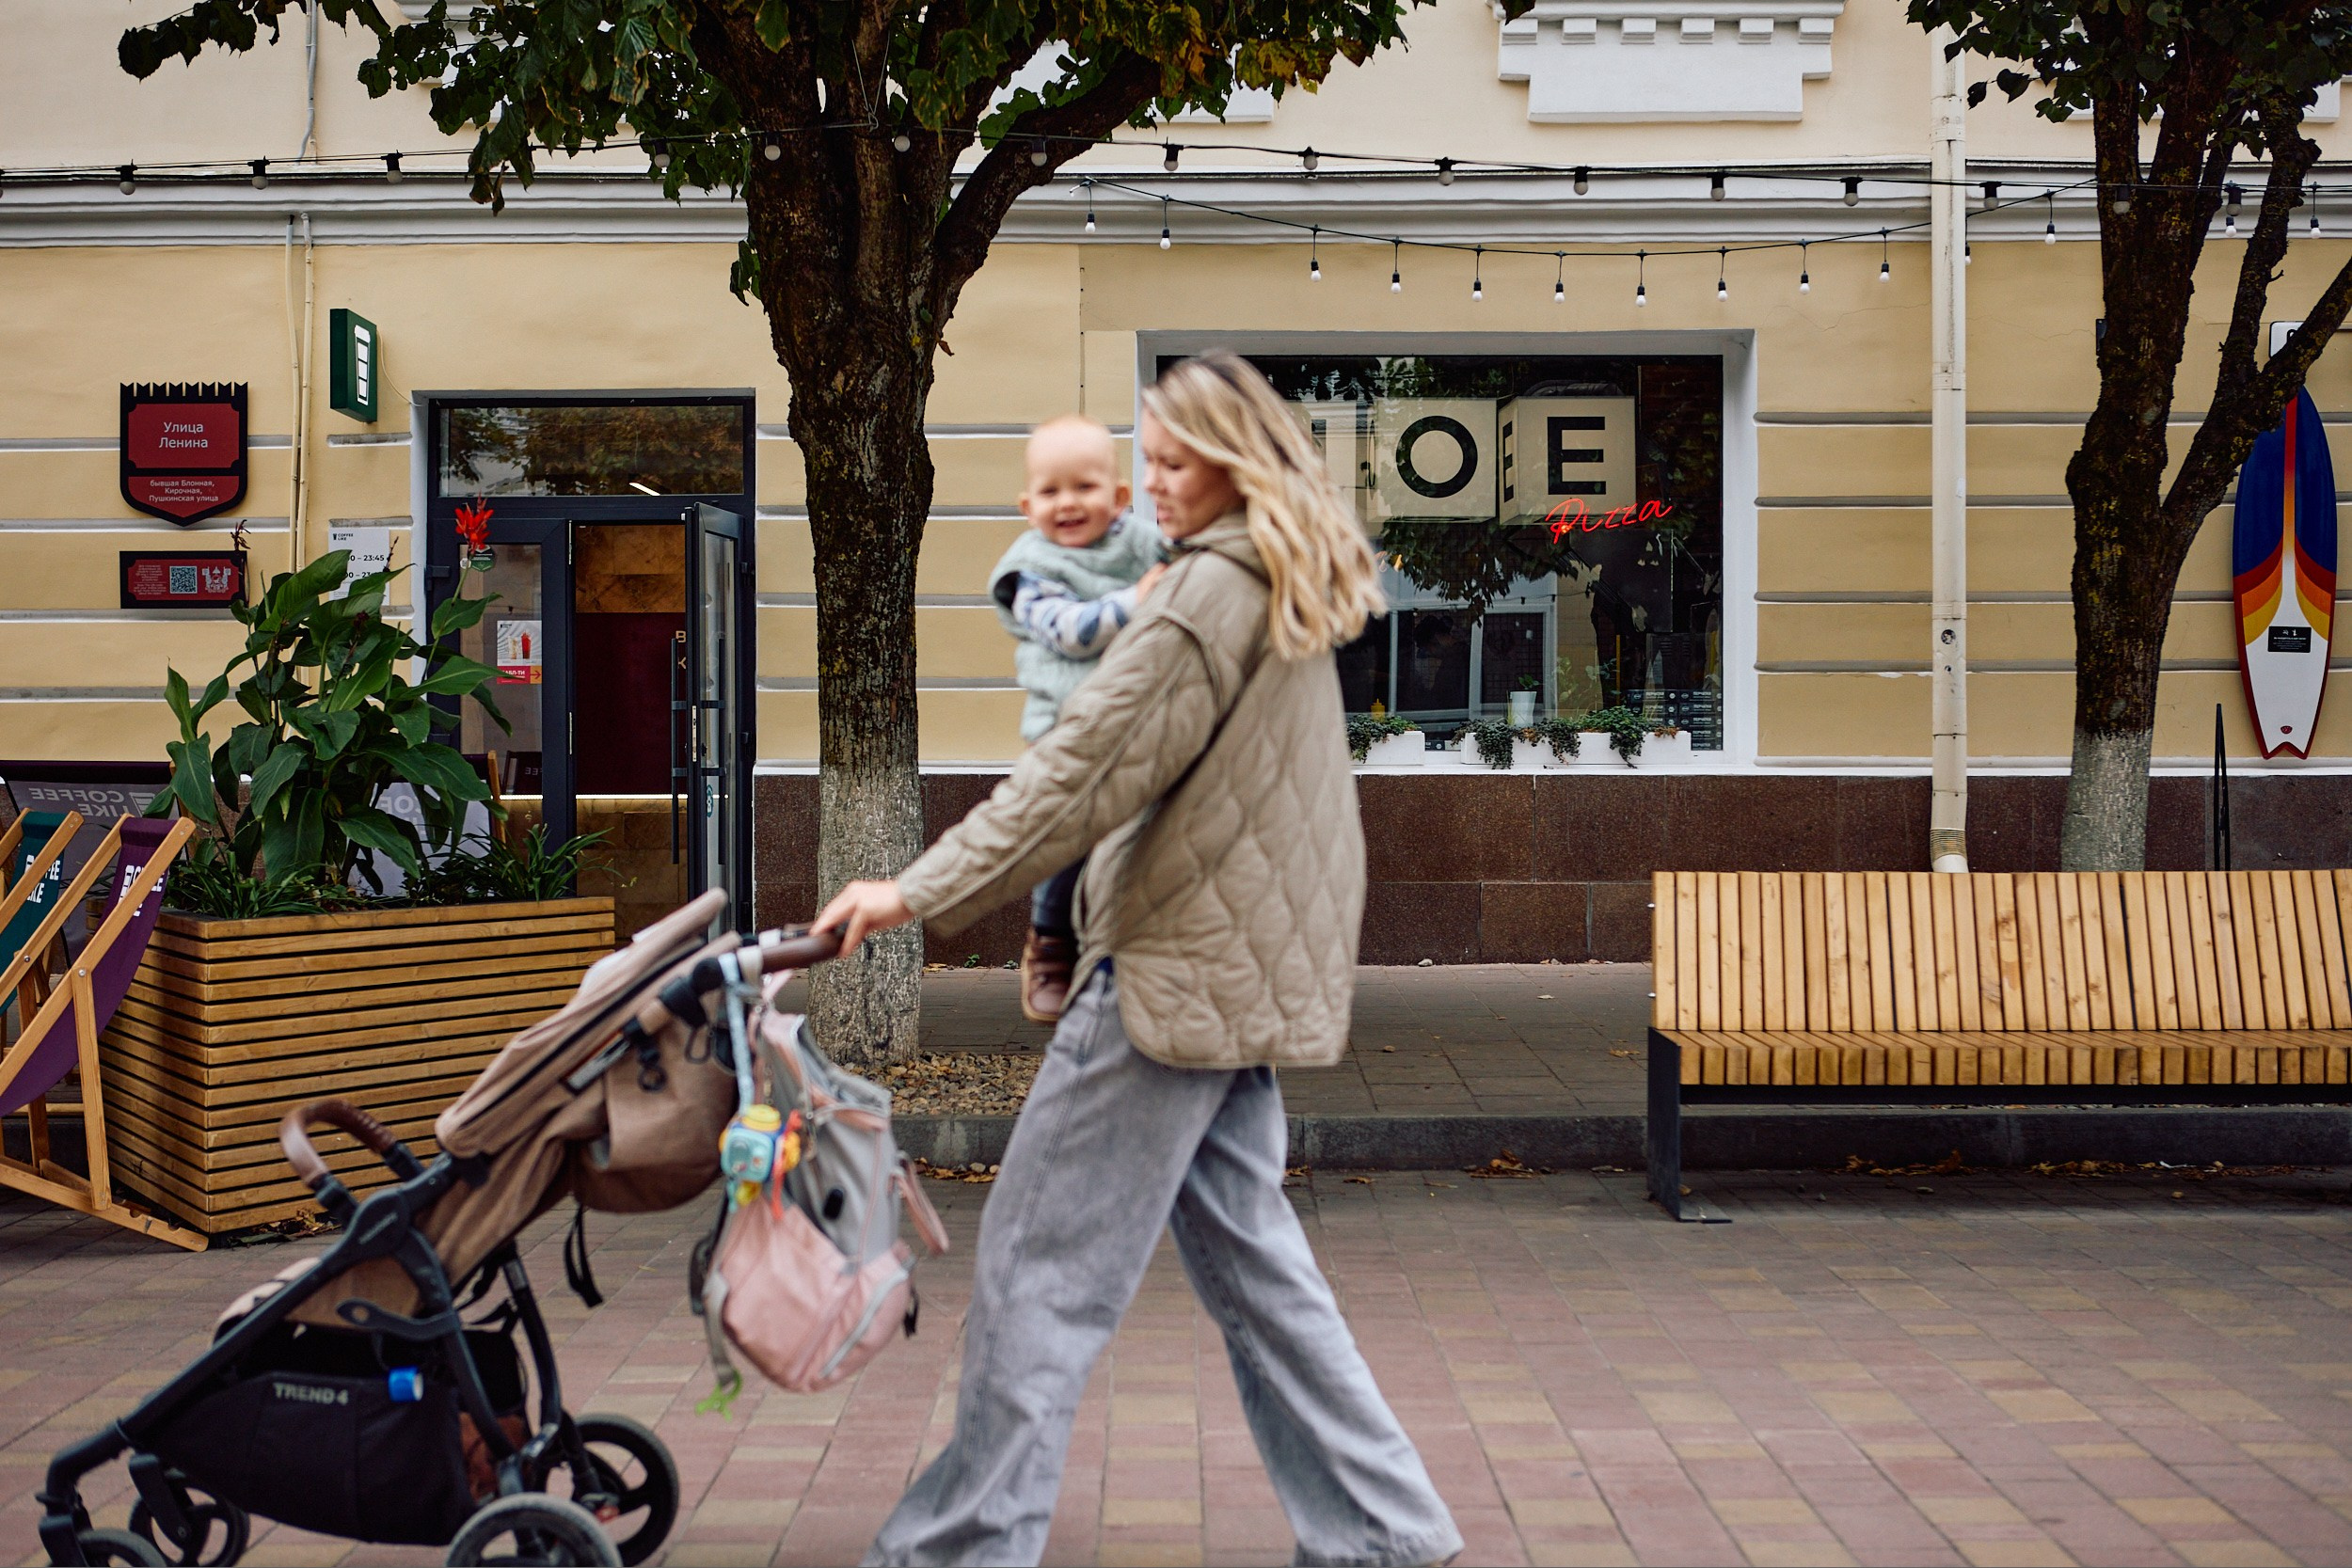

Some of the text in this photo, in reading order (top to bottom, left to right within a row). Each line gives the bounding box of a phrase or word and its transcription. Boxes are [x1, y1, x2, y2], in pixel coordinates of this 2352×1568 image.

[163, 421, 204, 434] Улица
[159, 437, 208, 448] Ленина
[1545, 499, 1674, 545] Pizza
[273, 1382, 349, 1405] TREND 4
